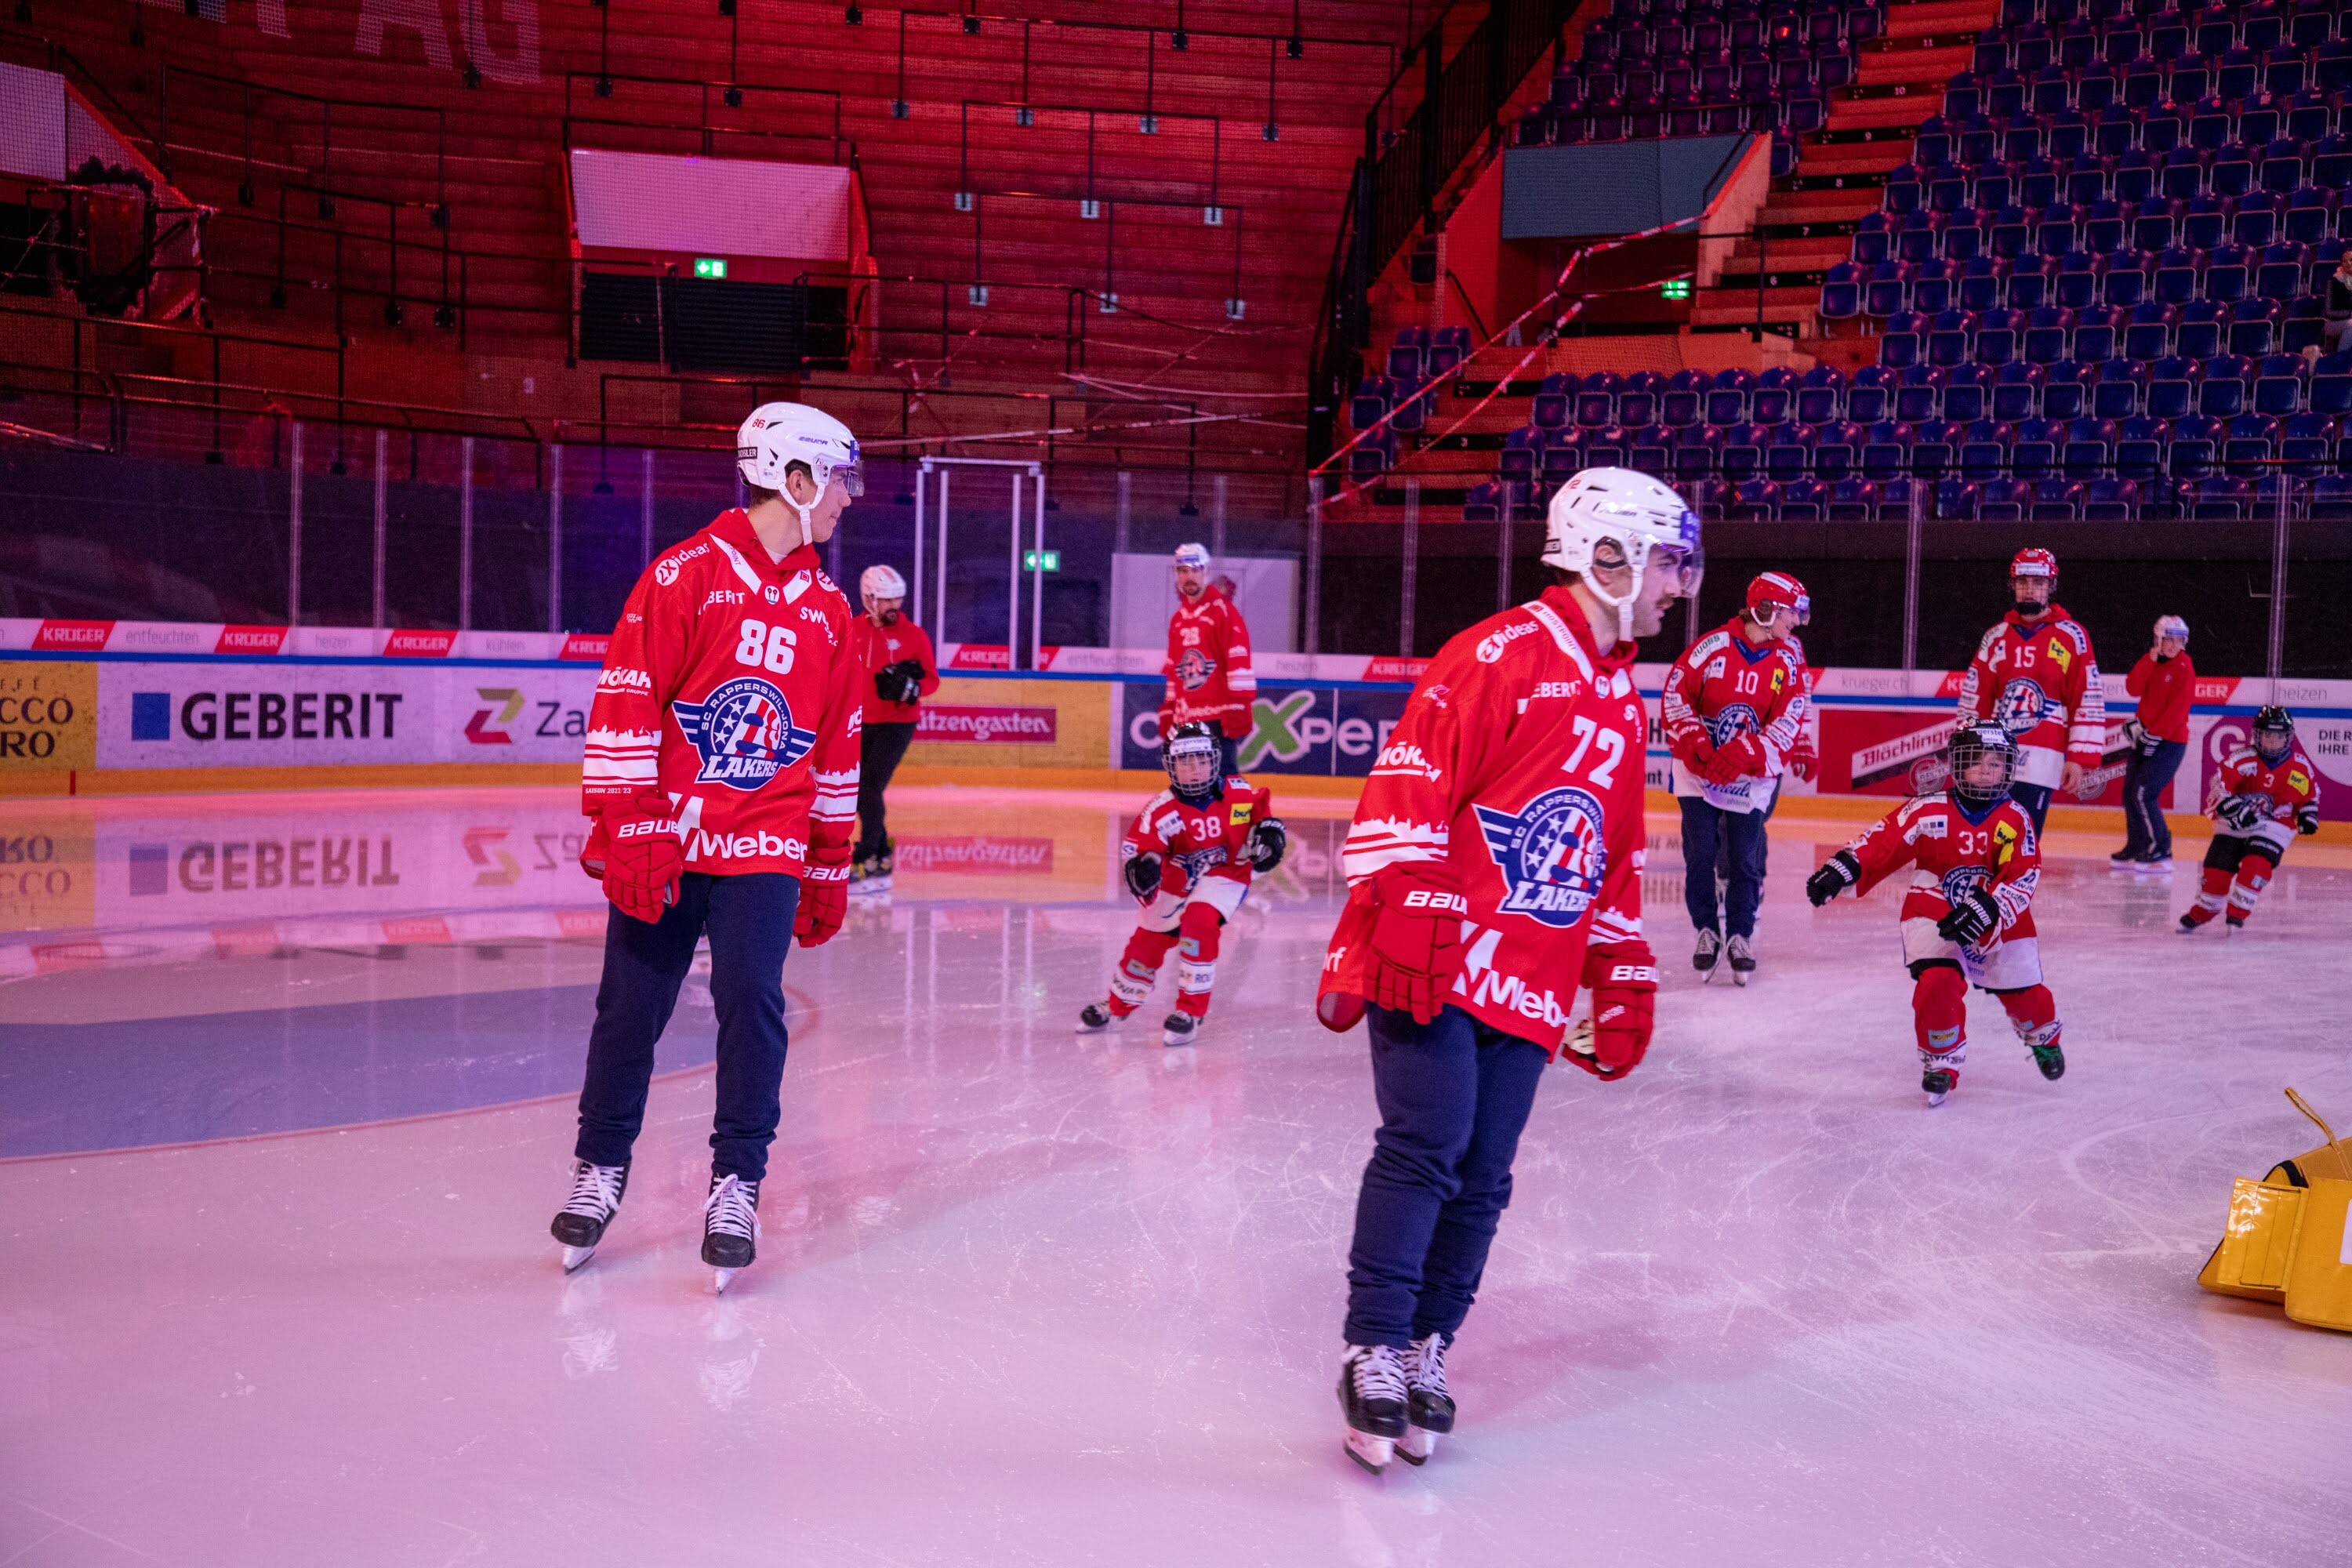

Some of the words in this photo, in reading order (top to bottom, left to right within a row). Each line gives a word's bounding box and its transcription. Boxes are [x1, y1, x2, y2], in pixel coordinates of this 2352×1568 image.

[753, 419, 765, 429] 86
[735, 619, 797, 675] 86
[2014, 646, 2037, 668] 15
[1734, 670, 1759, 695] 10
[181, 692, 402, 741] GEBERIT
[701, 712, 712, 731] SC
[2319, 730, 2340, 741] DIE
[1560, 715, 1625, 790] 72
[2318, 745, 2347, 755] IHRE
[702, 755, 779, 779] LAKERS
[1191, 816, 1221, 842] 38
[700, 829, 808, 862] Weber
